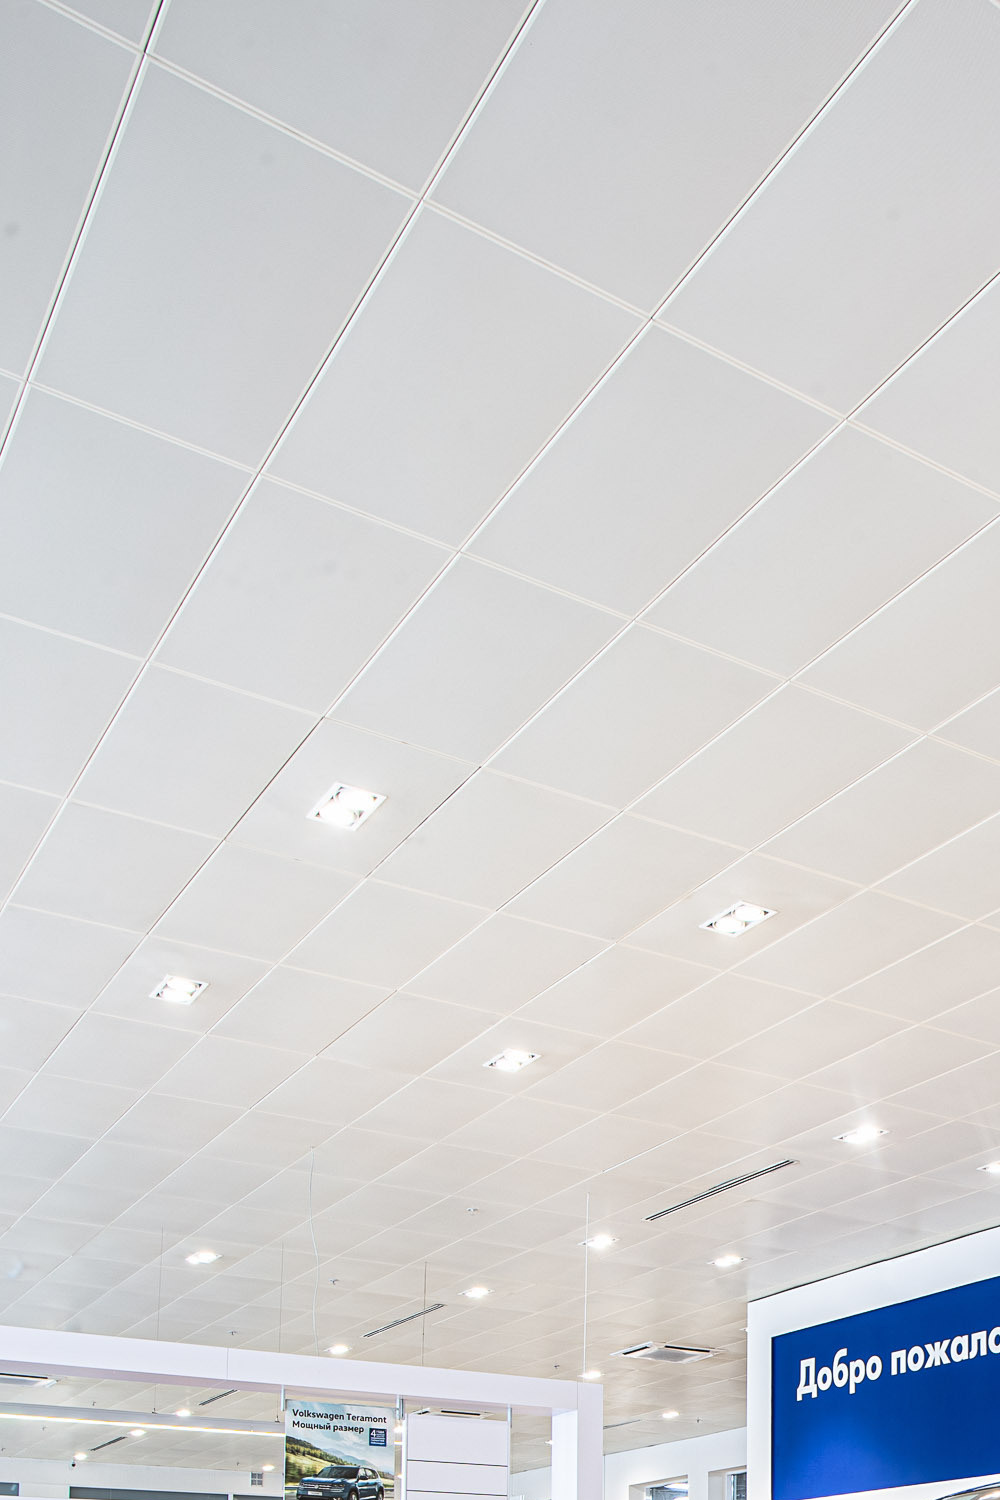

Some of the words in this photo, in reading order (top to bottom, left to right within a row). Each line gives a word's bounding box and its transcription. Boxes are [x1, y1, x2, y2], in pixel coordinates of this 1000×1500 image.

[796, 1348, 882, 1402] Добро
[292, 1408, 344, 1421] Volkswagen
[346, 1413, 387, 1424] Teramont
[292, 1420, 331, 1431] Мощный
[333, 1424, 364, 1434] размер
[370, 1429, 376, 1438] 4
